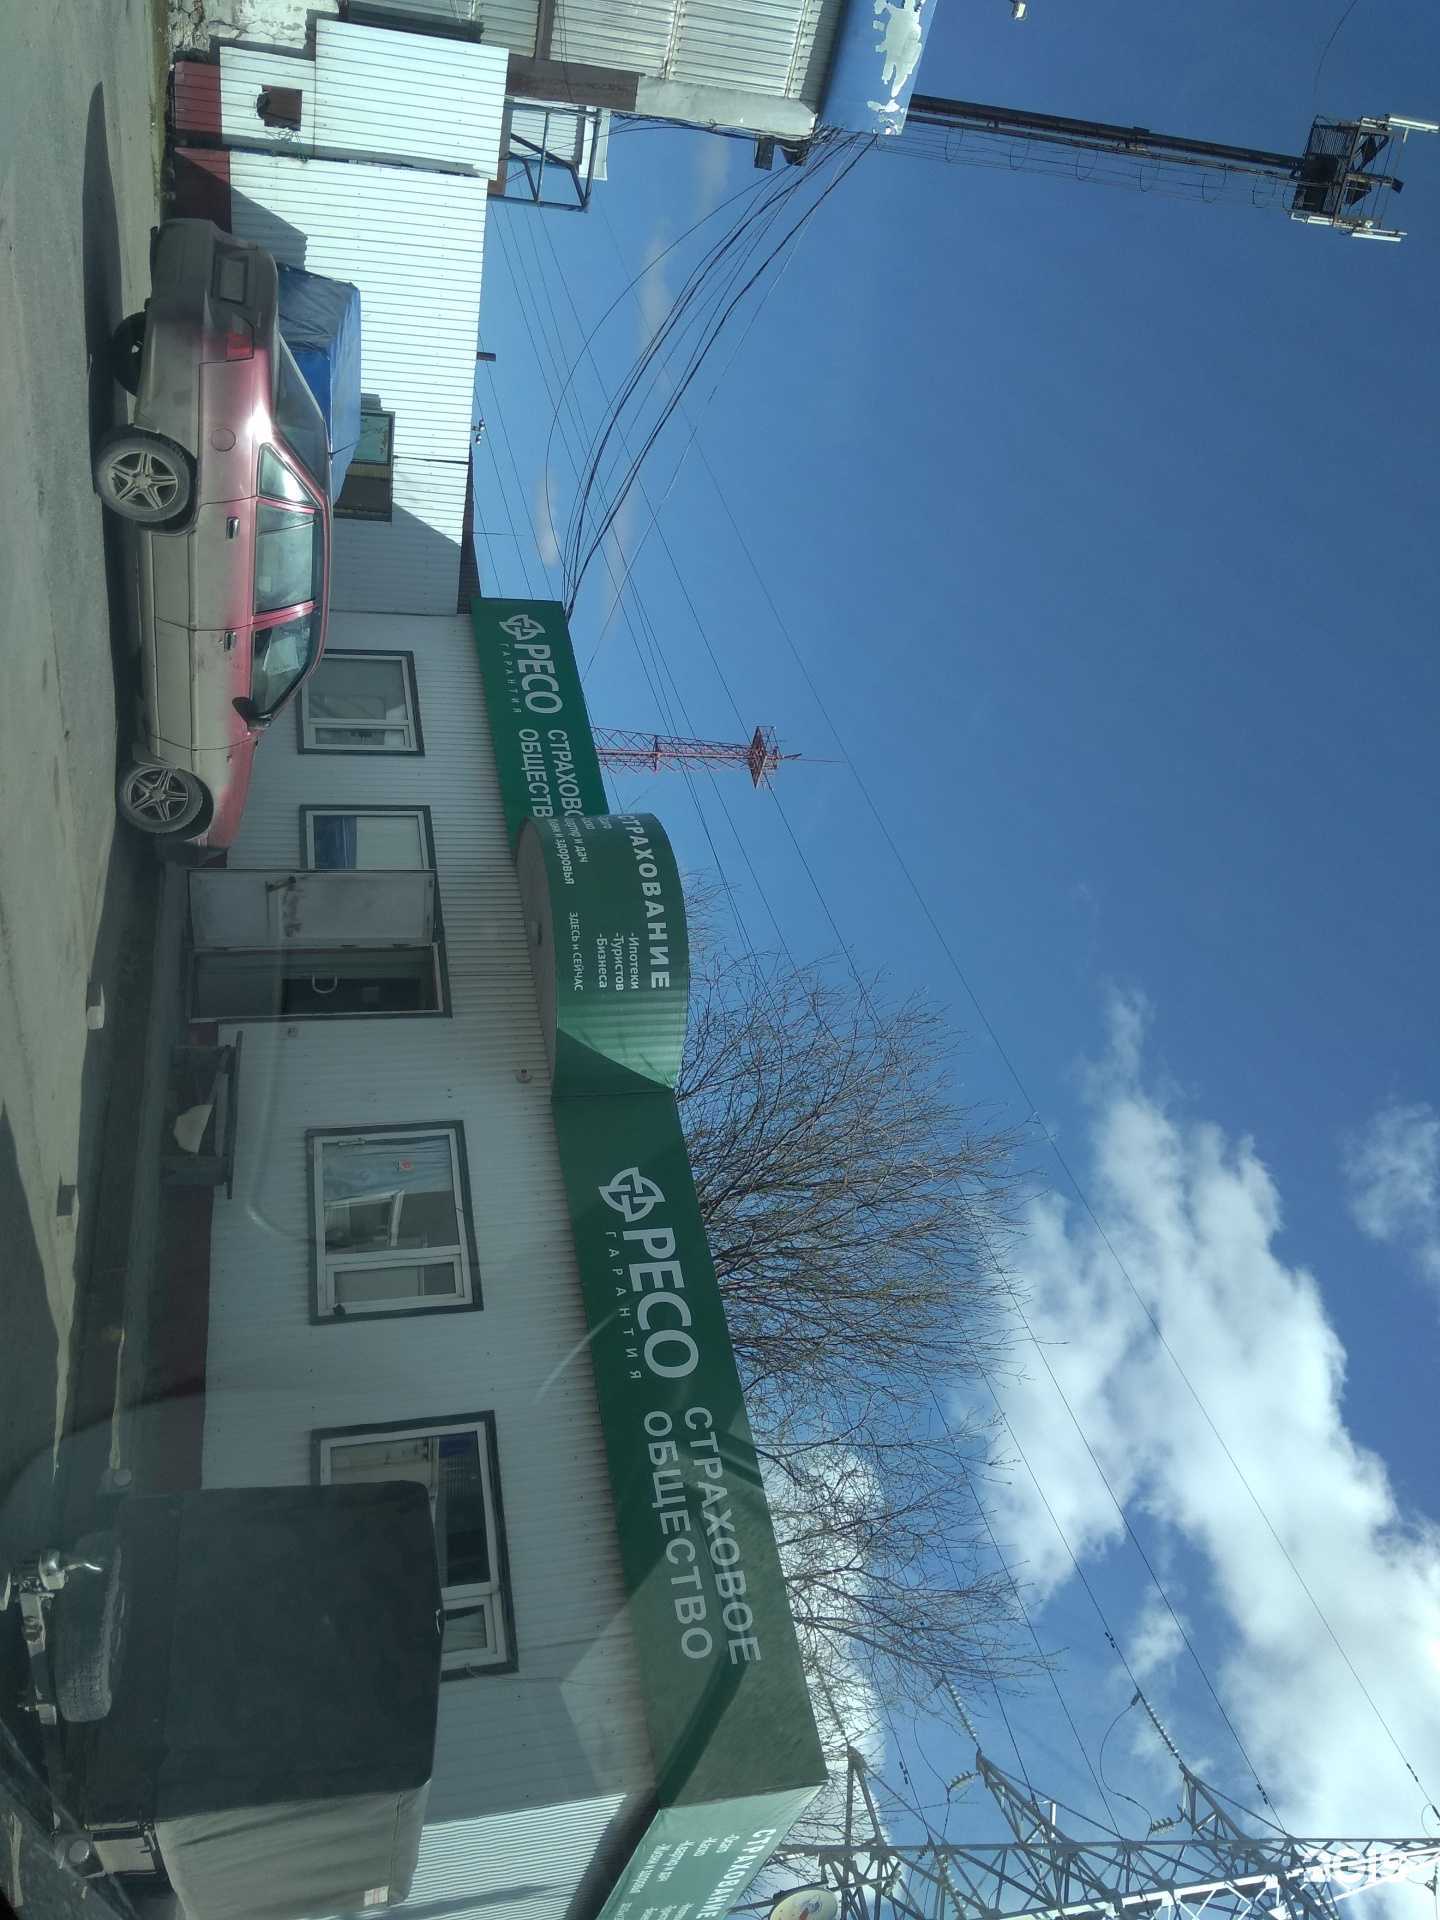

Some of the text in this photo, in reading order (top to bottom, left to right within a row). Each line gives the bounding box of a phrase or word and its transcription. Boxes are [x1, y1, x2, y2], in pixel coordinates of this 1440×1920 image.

[500, 644, 522, 713] ГАРАНТИЯ
[514, 644, 564, 714] РЕСО
[556, 839, 576, 884] здоровья
[568, 912, 581, 942] ЗДЕСЬ
[596, 933, 608, 988] -Бизнеса
[628, 933, 640, 990] -Ипотеки
[572, 952, 584, 992] СЕЙЧАС
[610, 933, 624, 991] -Туристов
[605, 1231, 642, 1379] ГАРАНТИЯ
[622, 1227, 699, 1378] РЕСО
[643, 1410, 712, 1660] ОБЩЕСТВО
[684, 1406, 762, 1665] СТРАХОВОЕ
[696, 1828, 776, 1919] СТРАХОВАНИЕ
